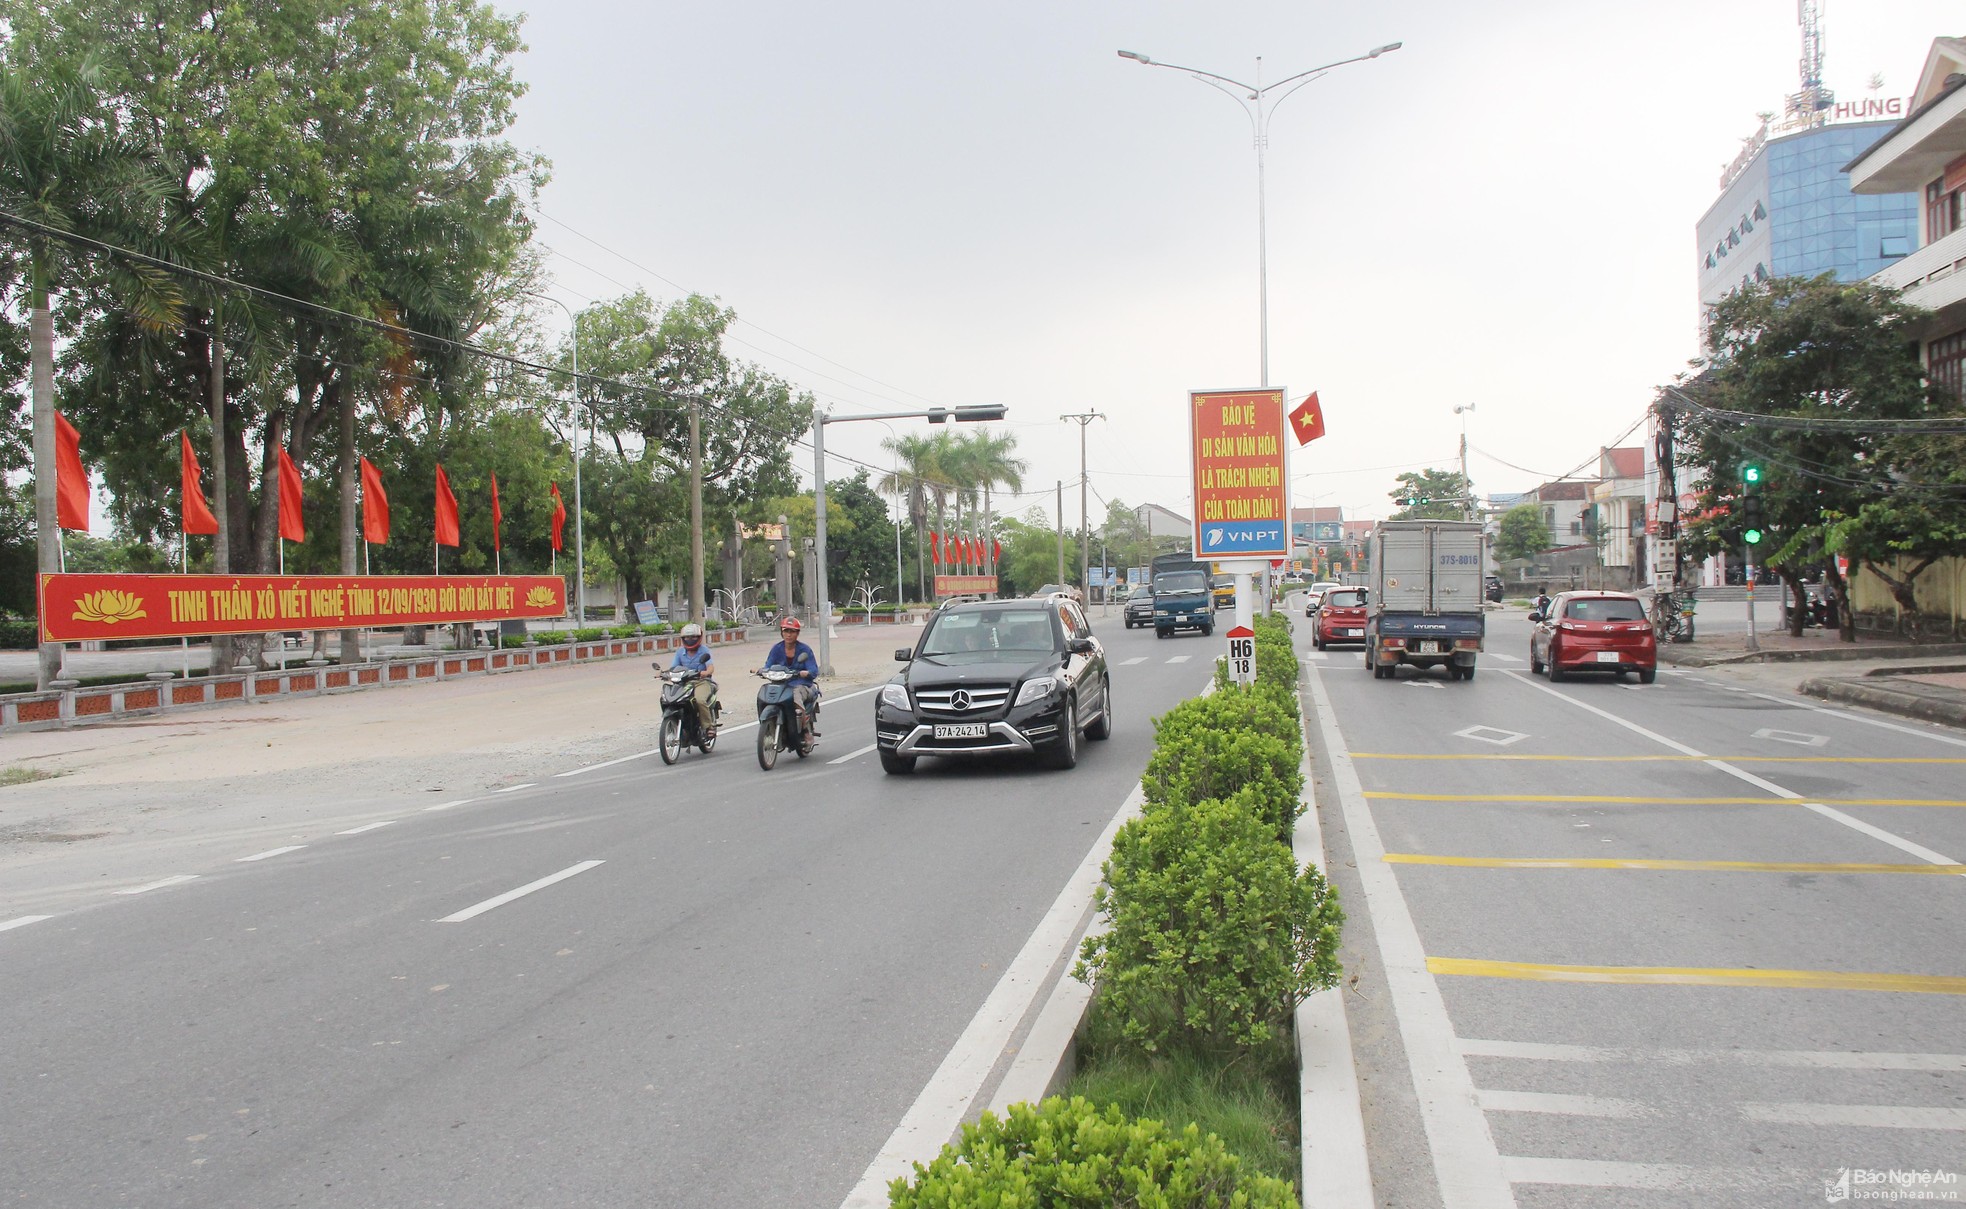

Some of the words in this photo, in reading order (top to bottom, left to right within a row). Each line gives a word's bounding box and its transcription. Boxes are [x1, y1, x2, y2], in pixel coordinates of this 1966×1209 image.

[1222, 399, 1241, 426] BẢO
[1244, 400, 1256, 429] VỆ
[1202, 438, 1212, 458] DI
[1214, 431, 1234, 457] SẢN
[1236, 432, 1256, 457] VĂN
[1258, 431, 1277, 455] HÓA
[1202, 465, 1214, 489] LÀ
[1215, 464, 1246, 488] TRÁCH
[1248, 463, 1279, 491] NHIỆM
[1204, 493, 1223, 520] CỦA
[1226, 495, 1250, 519] TOÀN
[1253, 494, 1272, 518] DÂN
[1275, 498, 1279, 518] !
[1228, 531, 1278, 541] VNPT
[168, 590, 208, 622] TINH
[211, 580, 252, 621] THẦN
[256, 583, 275, 620] XÔ
[279, 580, 307, 618] VIẾT
[310, 583, 345, 622] NGHỆ
[347, 583, 375, 616] TĨNH
[377, 588, 437, 615] 12/09/1930
[439, 582, 457, 613] ĐỜI
[459, 583, 474, 612] ĐỜI
[477, 579, 493, 611] BẤT
[496, 582, 514, 614] DIỆT
[1231, 639, 1252, 658] H6
[1235, 660, 1249, 673] 18
